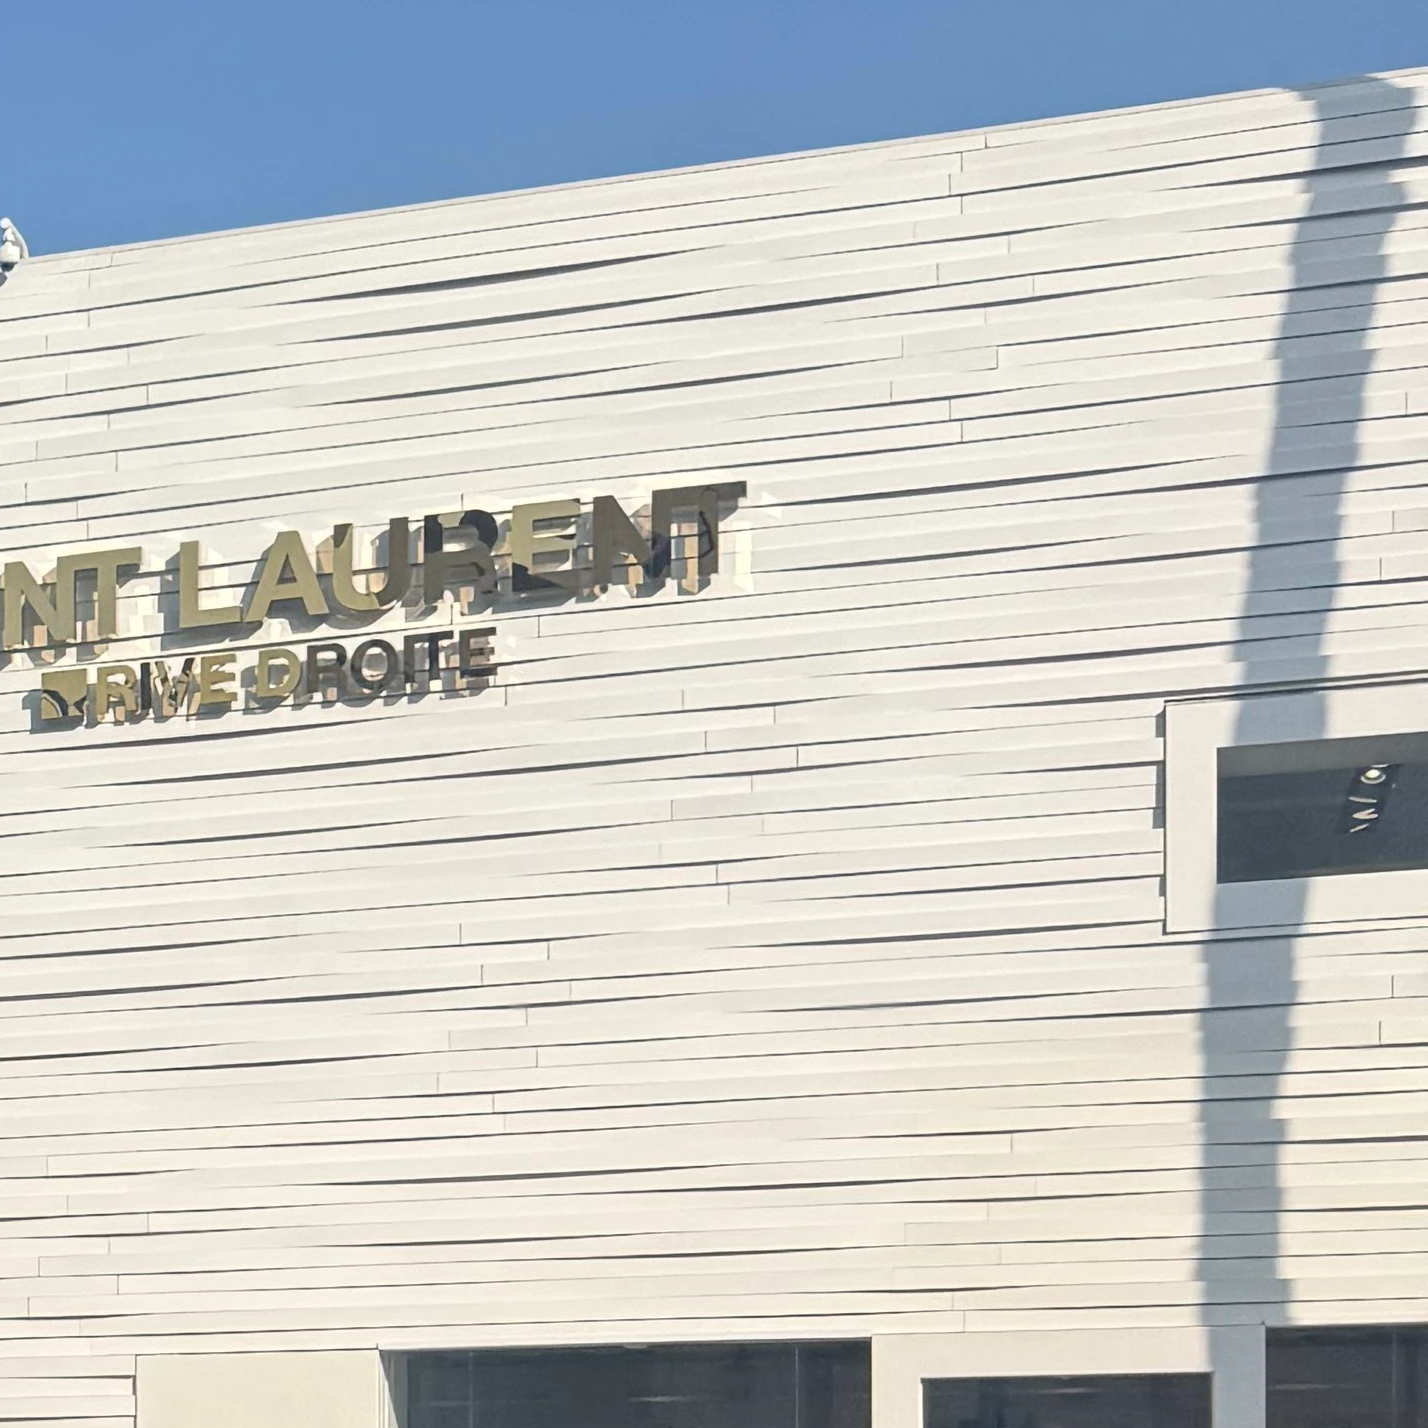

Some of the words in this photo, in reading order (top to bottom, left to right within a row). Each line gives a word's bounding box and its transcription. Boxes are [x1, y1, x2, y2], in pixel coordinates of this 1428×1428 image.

[179, 480, 748, 629] LAURENT
[95, 653, 238, 724] RIVE
[256, 626, 498, 699] DROITE
